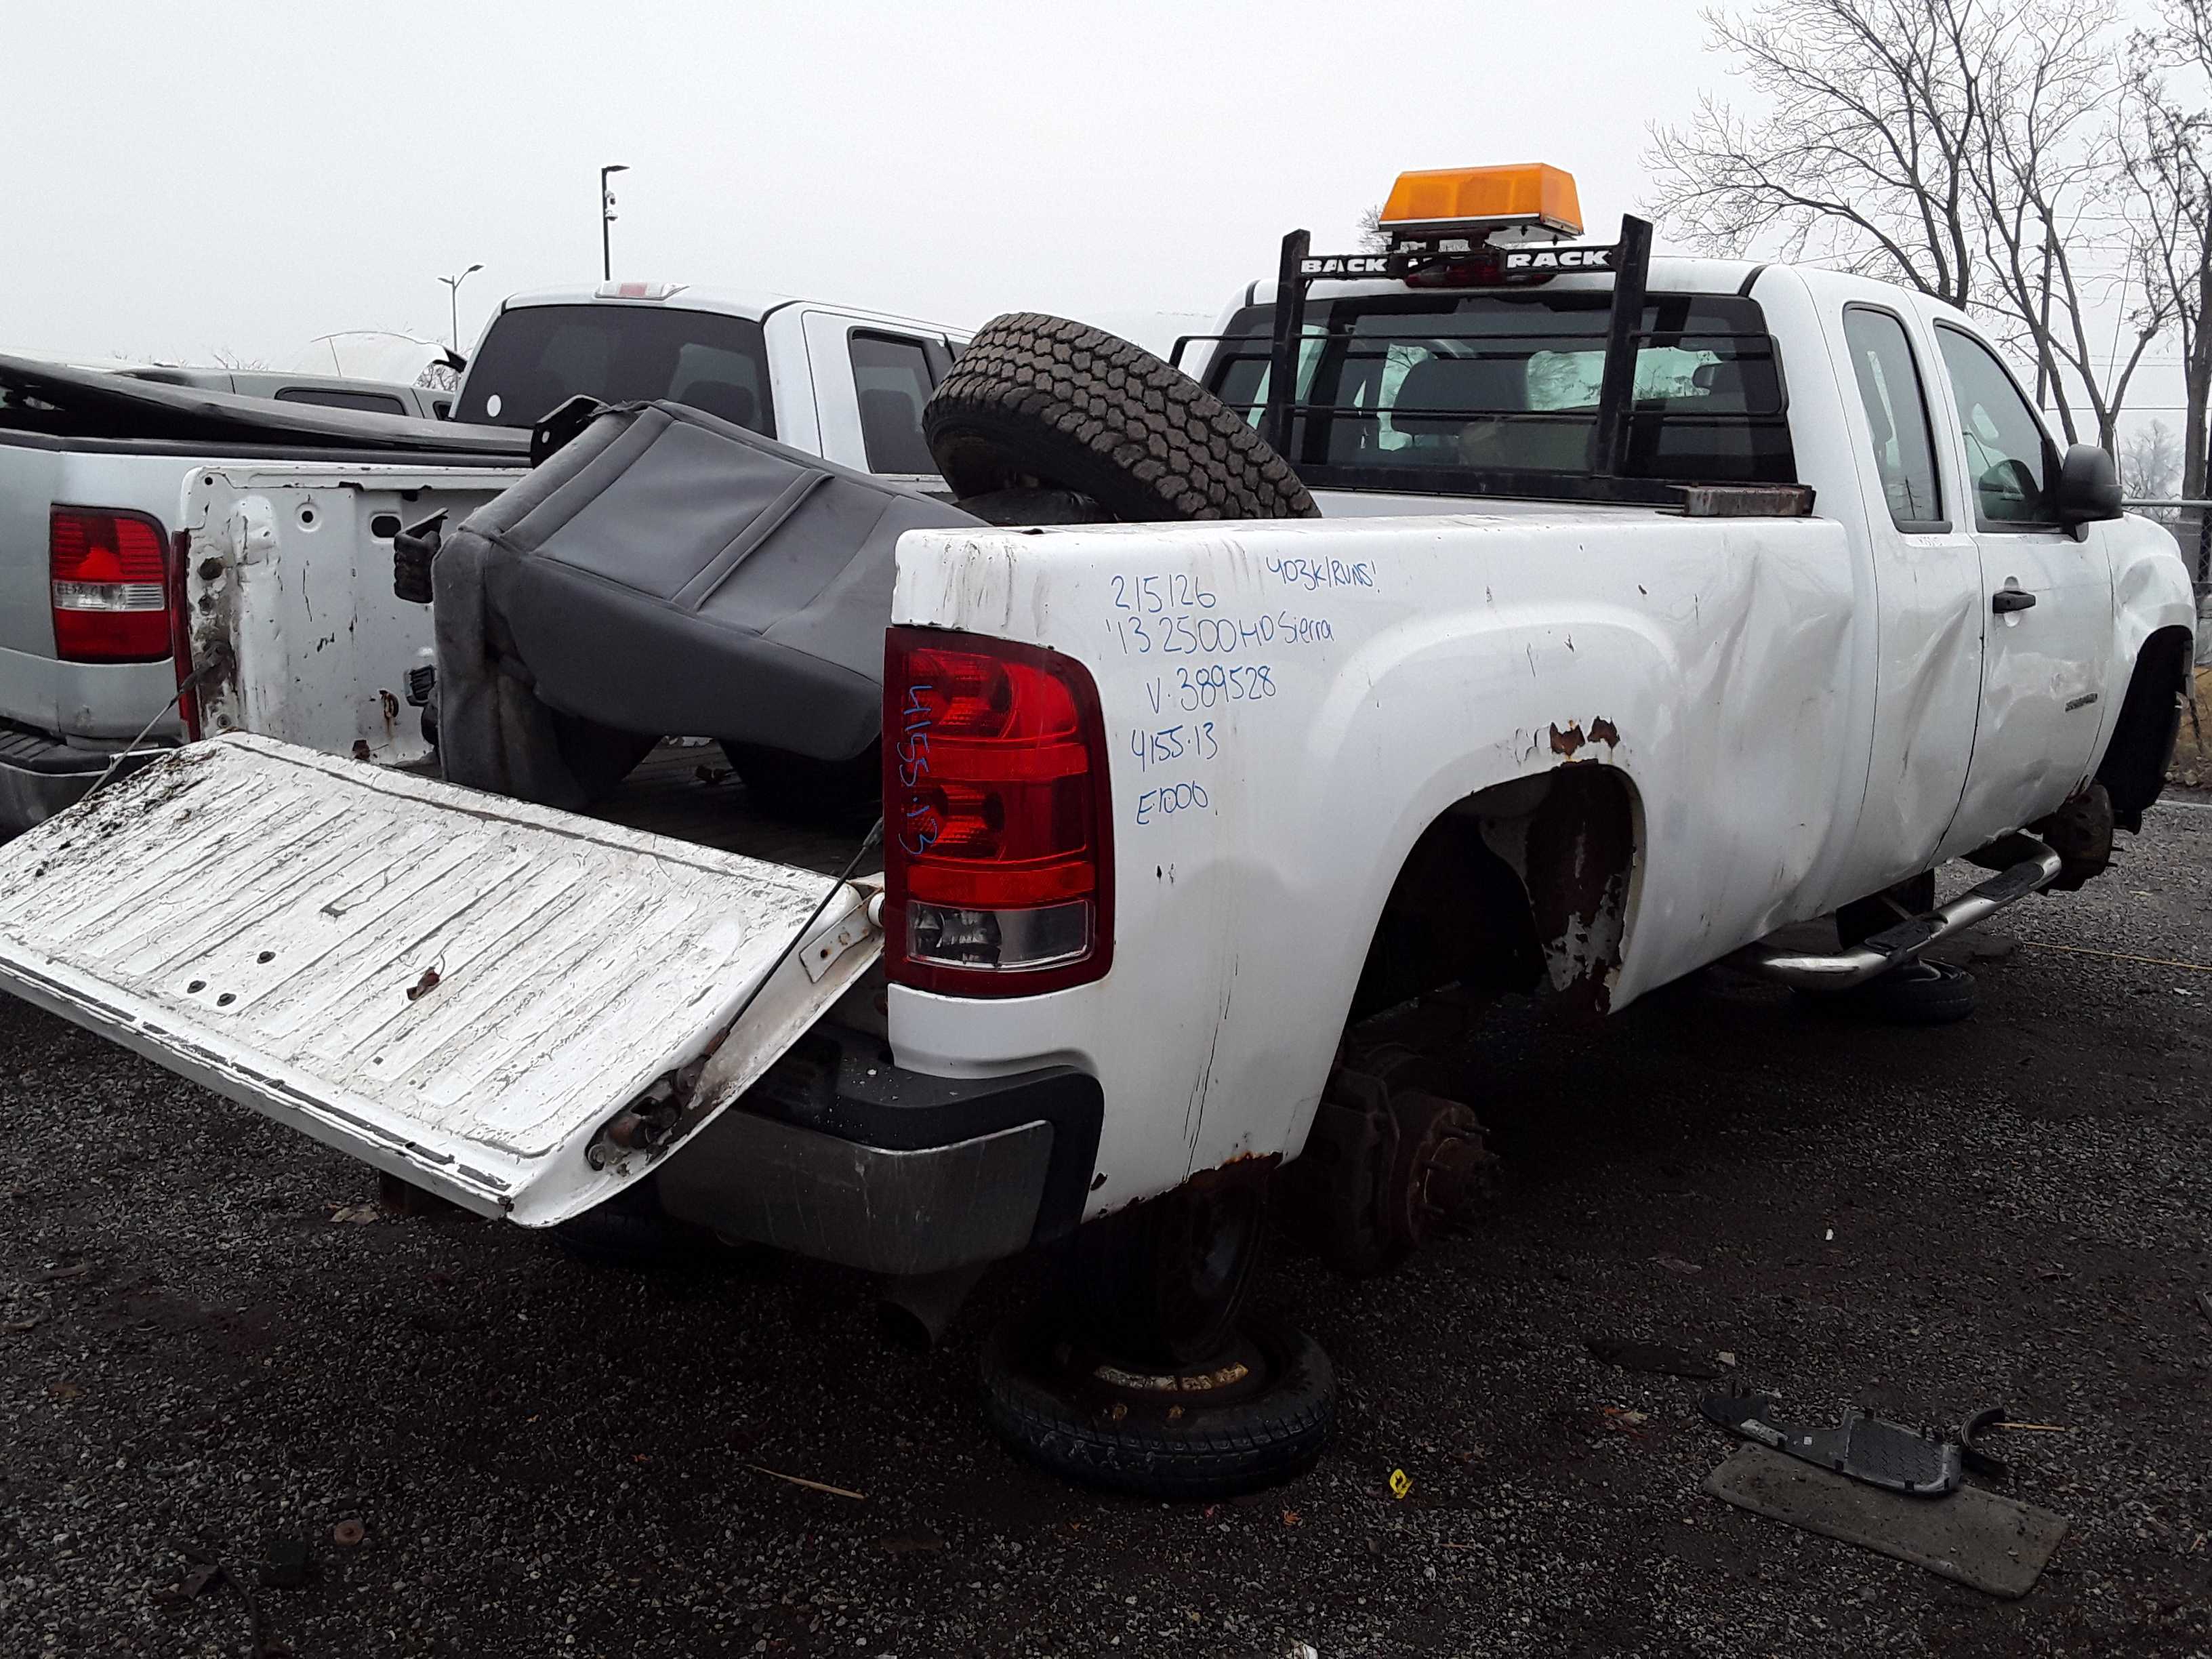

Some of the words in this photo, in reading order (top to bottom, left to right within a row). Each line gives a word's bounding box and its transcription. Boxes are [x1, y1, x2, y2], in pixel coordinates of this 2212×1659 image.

[1300, 258, 1388, 274] BACK
[1506, 250, 1610, 269] RACK
[1111, 574, 1216, 613] 215126
[1277, 610, 1334, 644] Sierra
